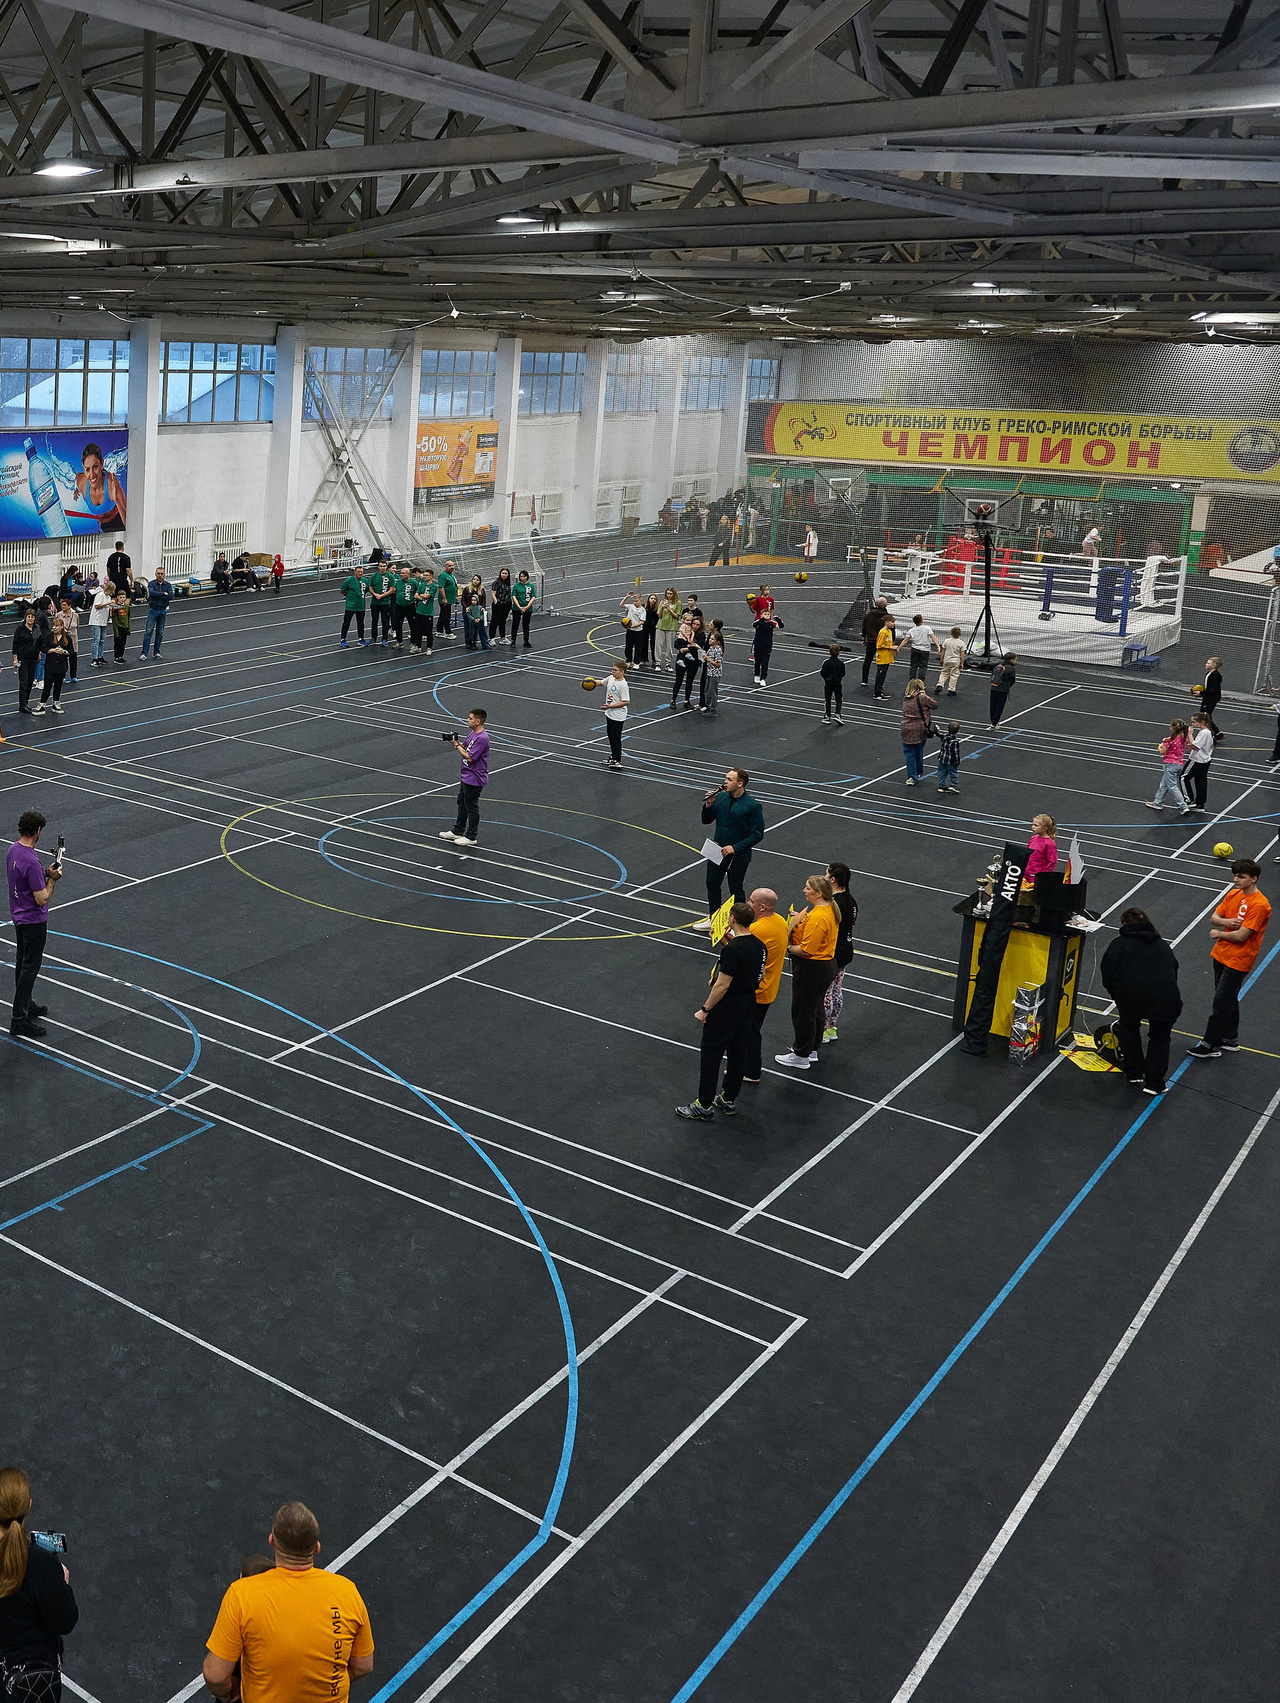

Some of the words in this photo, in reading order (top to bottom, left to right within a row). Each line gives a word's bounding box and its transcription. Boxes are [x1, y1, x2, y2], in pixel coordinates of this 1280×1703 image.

[845, 413, 947, 430] СПОРТИВНЫЙ
[953, 416, 991, 432] КЛУБ
[997, 418, 1132, 437] ГРЕКО-РИМСКОЙ
[1139, 423, 1213, 441] БОРЬБЫ
[417, 435, 448, 453] -50%
[882, 430, 1162, 469] ЧЕМПИОН
[1000, 865, 1022, 901] АКТО
[330, 1606, 341, 1634] мы
[333, 1640, 342, 1660] не
